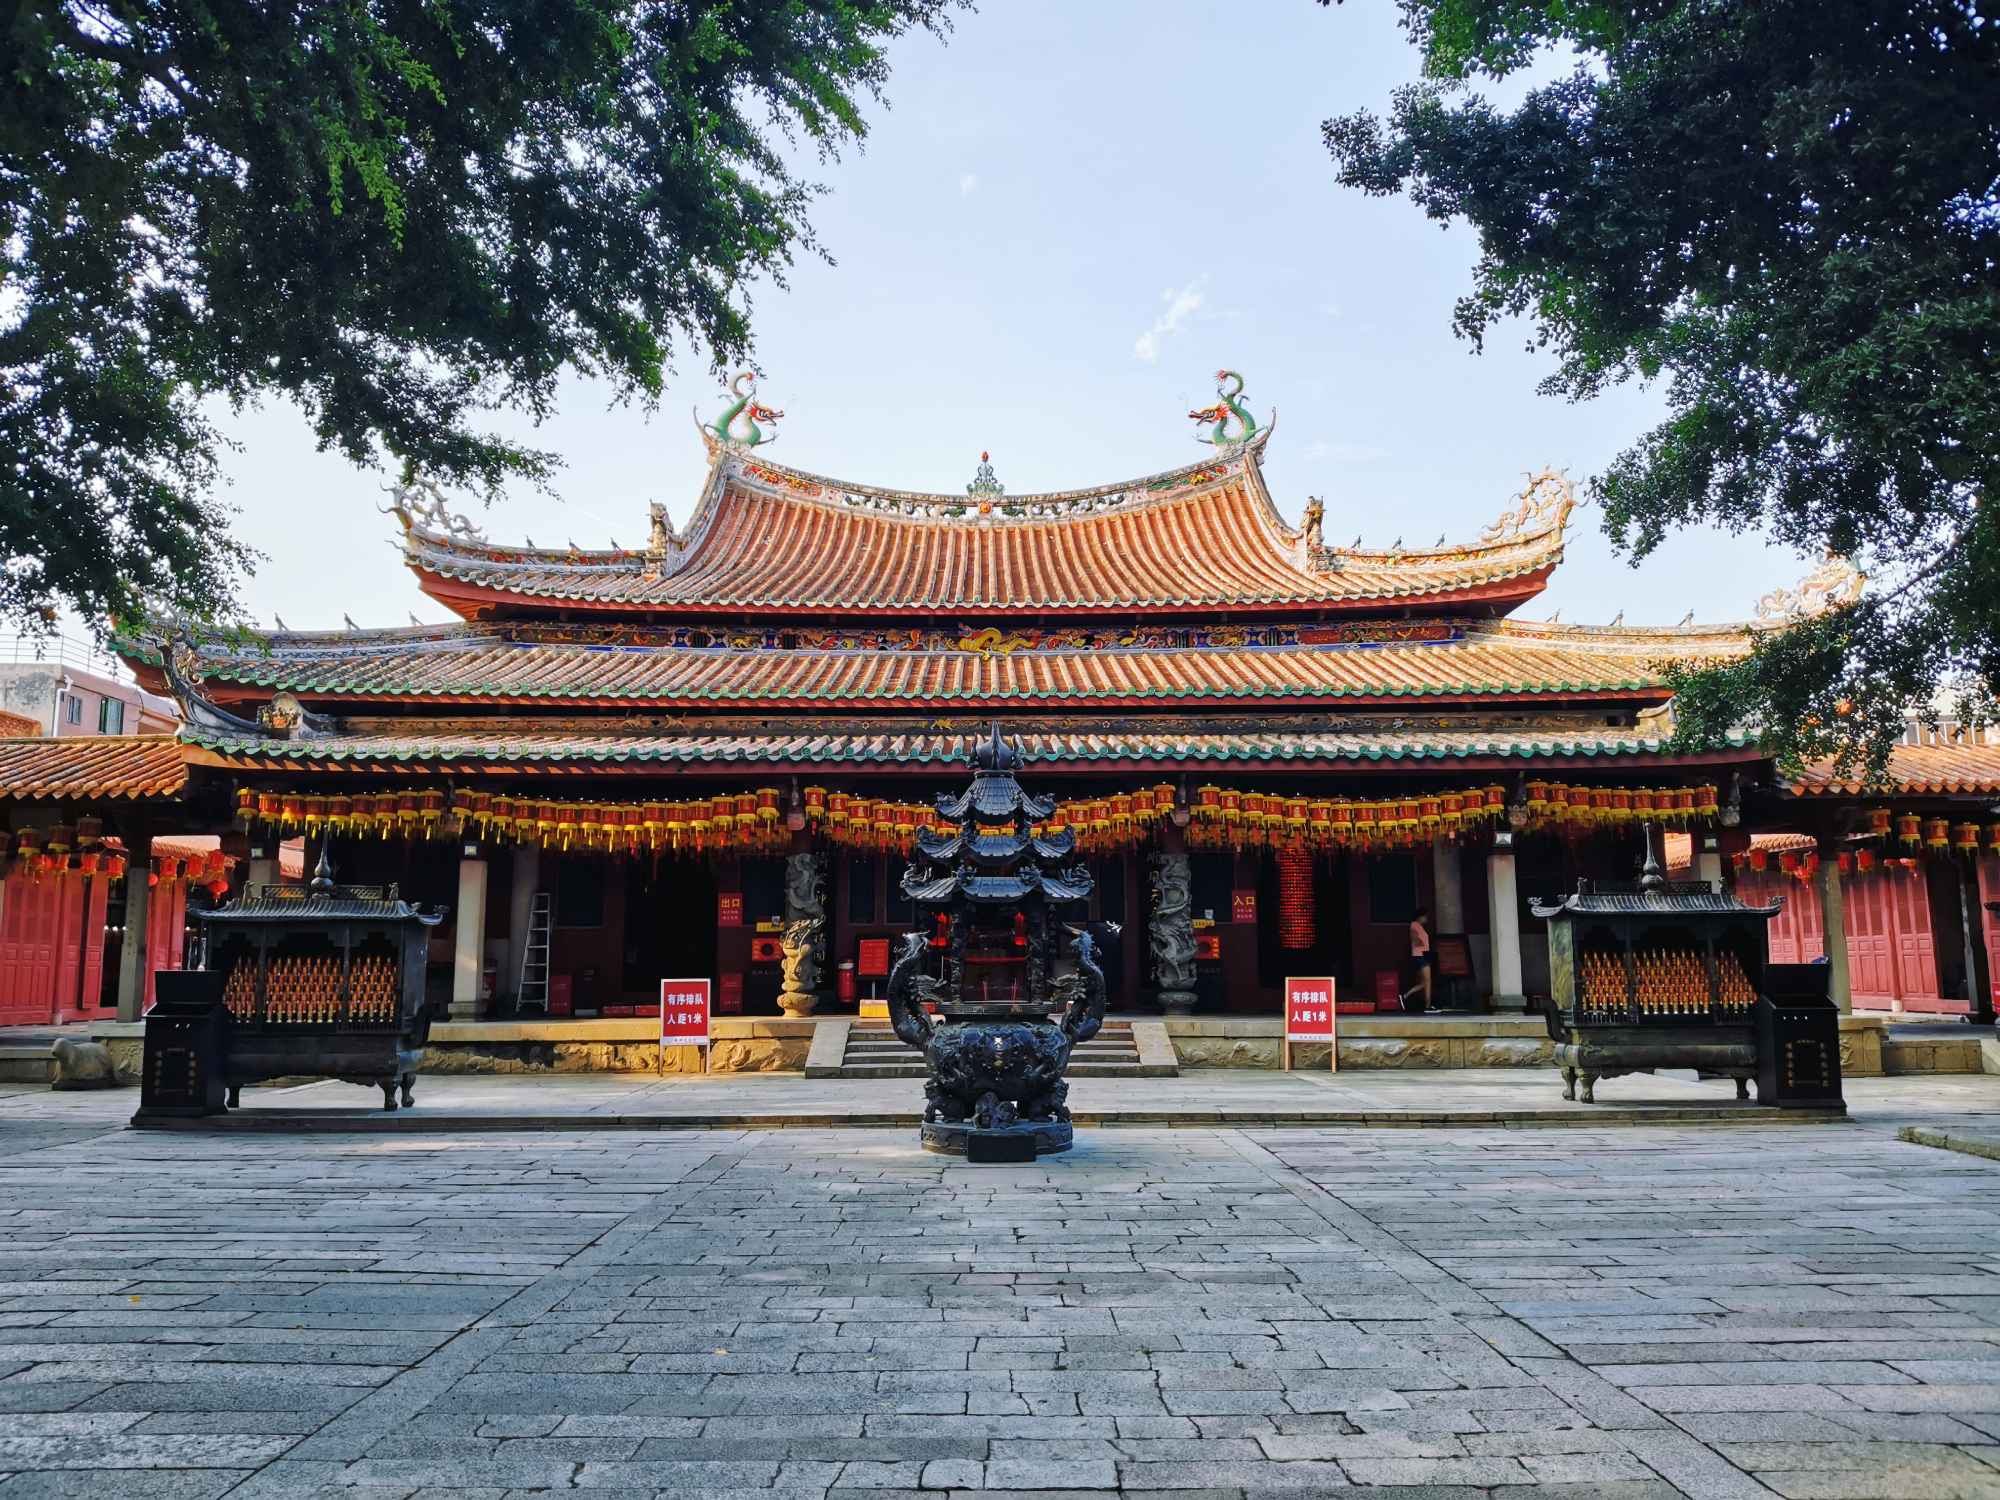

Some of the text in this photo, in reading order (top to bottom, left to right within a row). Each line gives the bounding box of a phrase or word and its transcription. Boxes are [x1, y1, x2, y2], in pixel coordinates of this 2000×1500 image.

[721, 898, 740, 908] 出口
[1233, 895, 1255, 906] 入口
[667, 993, 704, 1005] 有序排队
[1292, 991, 1328, 1003] 有序排队
[667, 1013, 702, 1025] 人距1米
[1292, 1010, 1327, 1022] 人距1米
